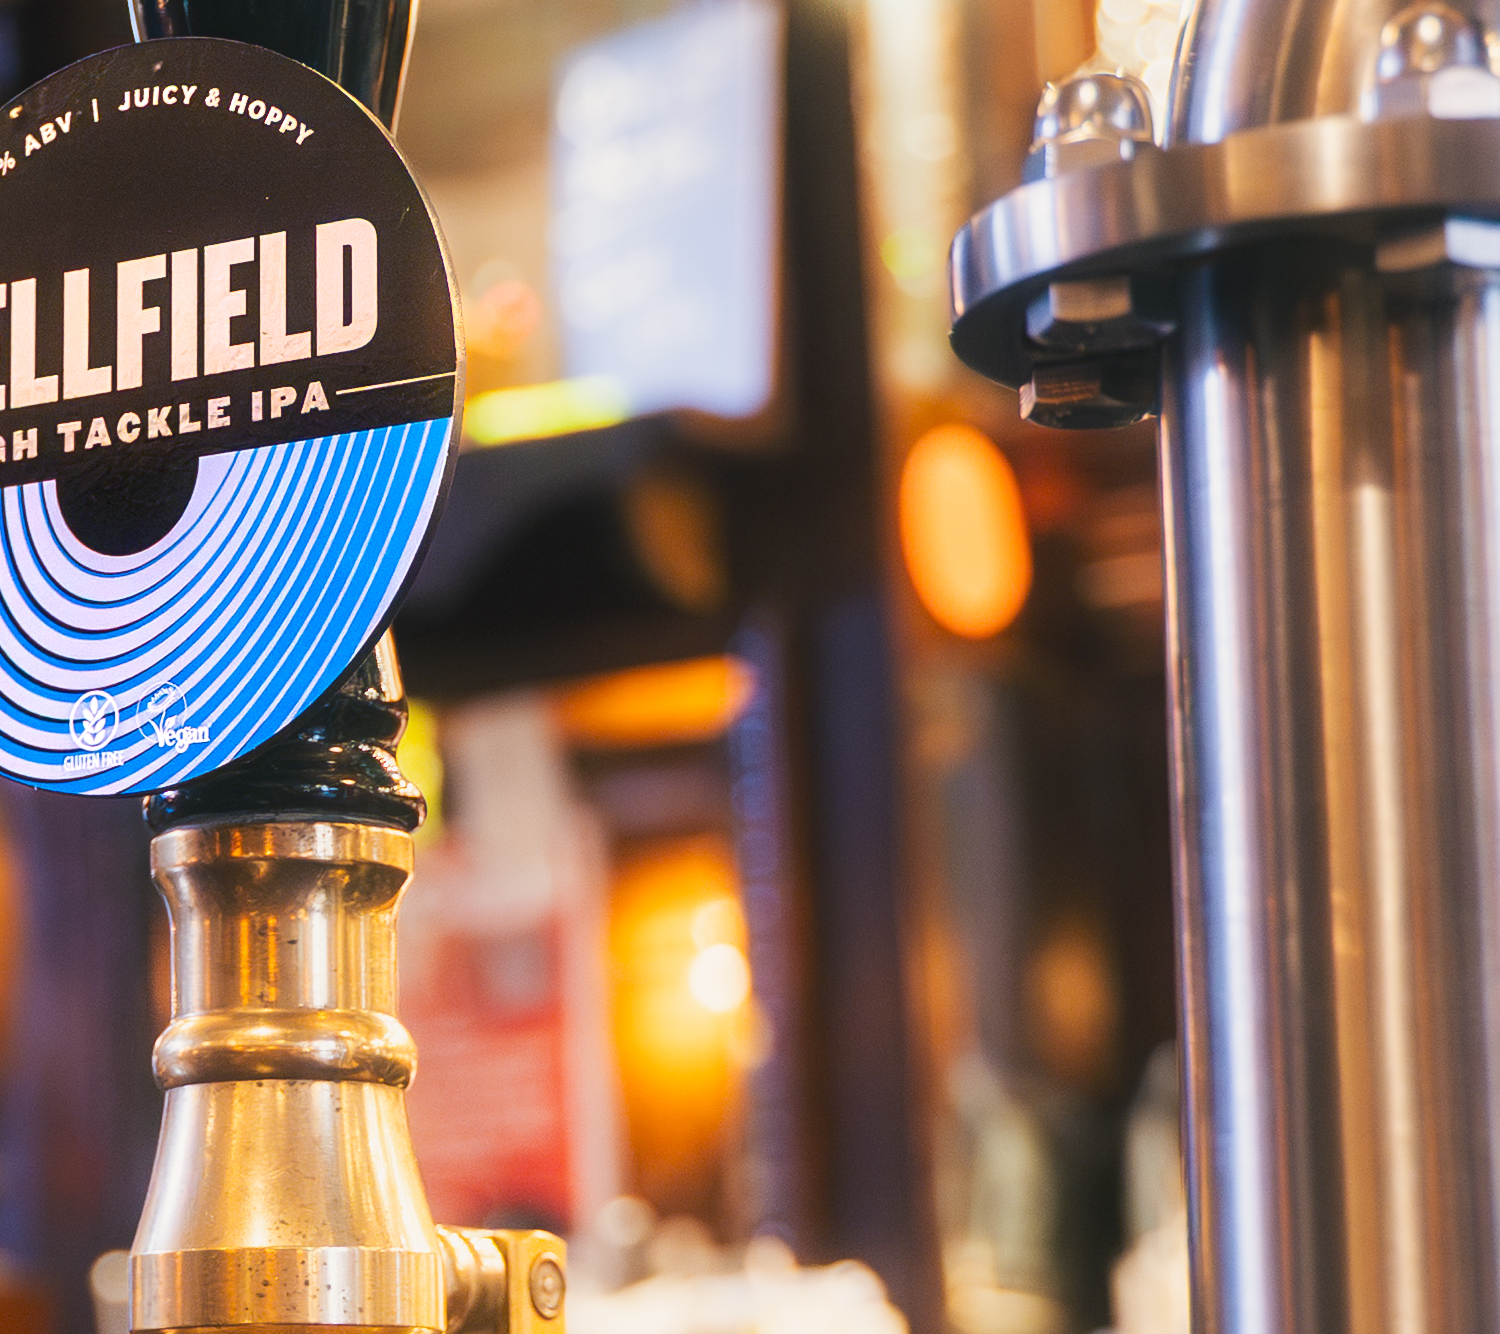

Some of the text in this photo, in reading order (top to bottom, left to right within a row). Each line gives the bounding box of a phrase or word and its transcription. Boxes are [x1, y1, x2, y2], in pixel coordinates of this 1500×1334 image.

[24, 111, 72, 157] ABV
[117, 84, 198, 112] JUICY
[204, 87, 221, 108] &
[228, 92, 314, 146] HOPPY
[56, 395, 231, 453] TACKLE
[250, 380, 331, 423] IPA
[63, 749, 125, 771] GLUTEN FREE
[148, 714, 211, 754] Vegan
